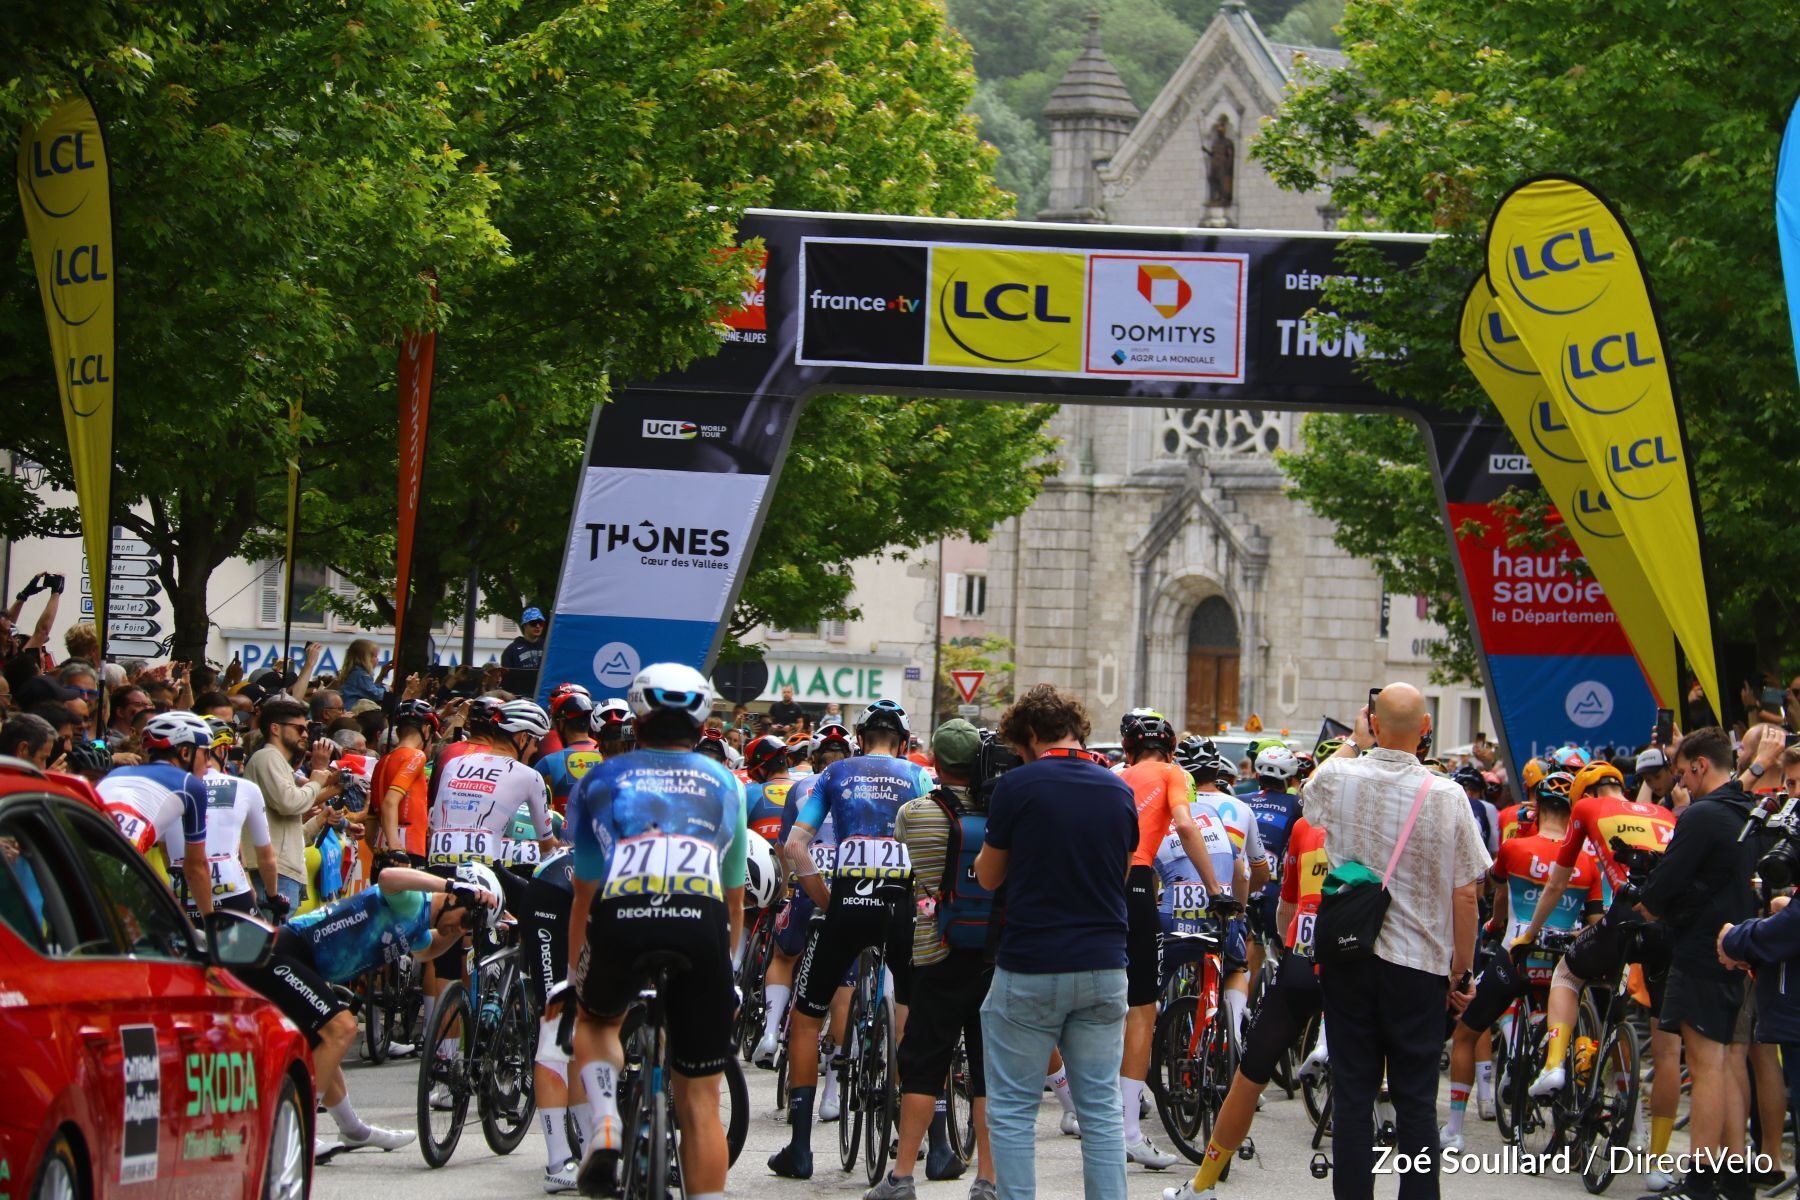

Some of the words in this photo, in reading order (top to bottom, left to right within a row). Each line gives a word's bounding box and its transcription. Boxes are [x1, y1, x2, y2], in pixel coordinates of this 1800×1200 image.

[34, 133, 95, 178] LCL
[56, 245, 108, 286] LCL
[1513, 227, 1615, 281] LCL
[953, 281, 1072, 323] LCL
[1111, 324, 1216, 344] DOMITYS
[1130, 354, 1154, 362] AG2R
[1170, 356, 1215, 364] MONDIALE
[1568, 332, 1656, 380] LCL
[68, 355, 109, 386] LCL
[647, 423, 677, 436] UCI
[700, 425, 727, 433] WORLD
[1494, 458, 1524, 471] UCI
[1610, 436, 1677, 474] LCL
[585, 519, 730, 562] THÔNES
[641, 556, 669, 567] Cœur
[671, 557, 689, 568] des
[692, 559, 729, 570] Vallées
[1493, 548, 1590, 578] haut
[1493, 579, 1604, 604] savoie
[1492, 608, 1506, 622] le
[1512, 607, 1619, 625] Départemen
[457, 764, 503, 782] UAE
[636, 768, 721, 788] DECATHLON
[679, 778, 697, 787] LA
[853, 775, 912, 789] DECATHLON
[449, 780, 494, 792] Emirates
[635, 785, 707, 797] MONDIALE
[854, 792, 899, 801] MONDIALE
[1248, 803, 1288, 813] upama
[1616, 824, 1646, 834] Uno
[432, 833, 452, 854] 16
[464, 833, 486, 854] 16
[843, 841, 867, 867] 21
[881, 841, 906, 867] 21
[617, 840, 656, 877] 27
[677, 841, 713, 876] 27
[605, 876, 658, 898] LCL
[668, 875, 721, 899] LCL
[1173, 886, 1206, 909] 183
[321, 909, 369, 937] DECATHLON
[616, 907, 702, 919] DECATHLON
[1301, 916, 1313, 944] 6
[797, 930, 820, 999] MONDIALE
[285, 972, 331, 1016] DECATHLON
[186, 1051, 259, 1117] SKODA
